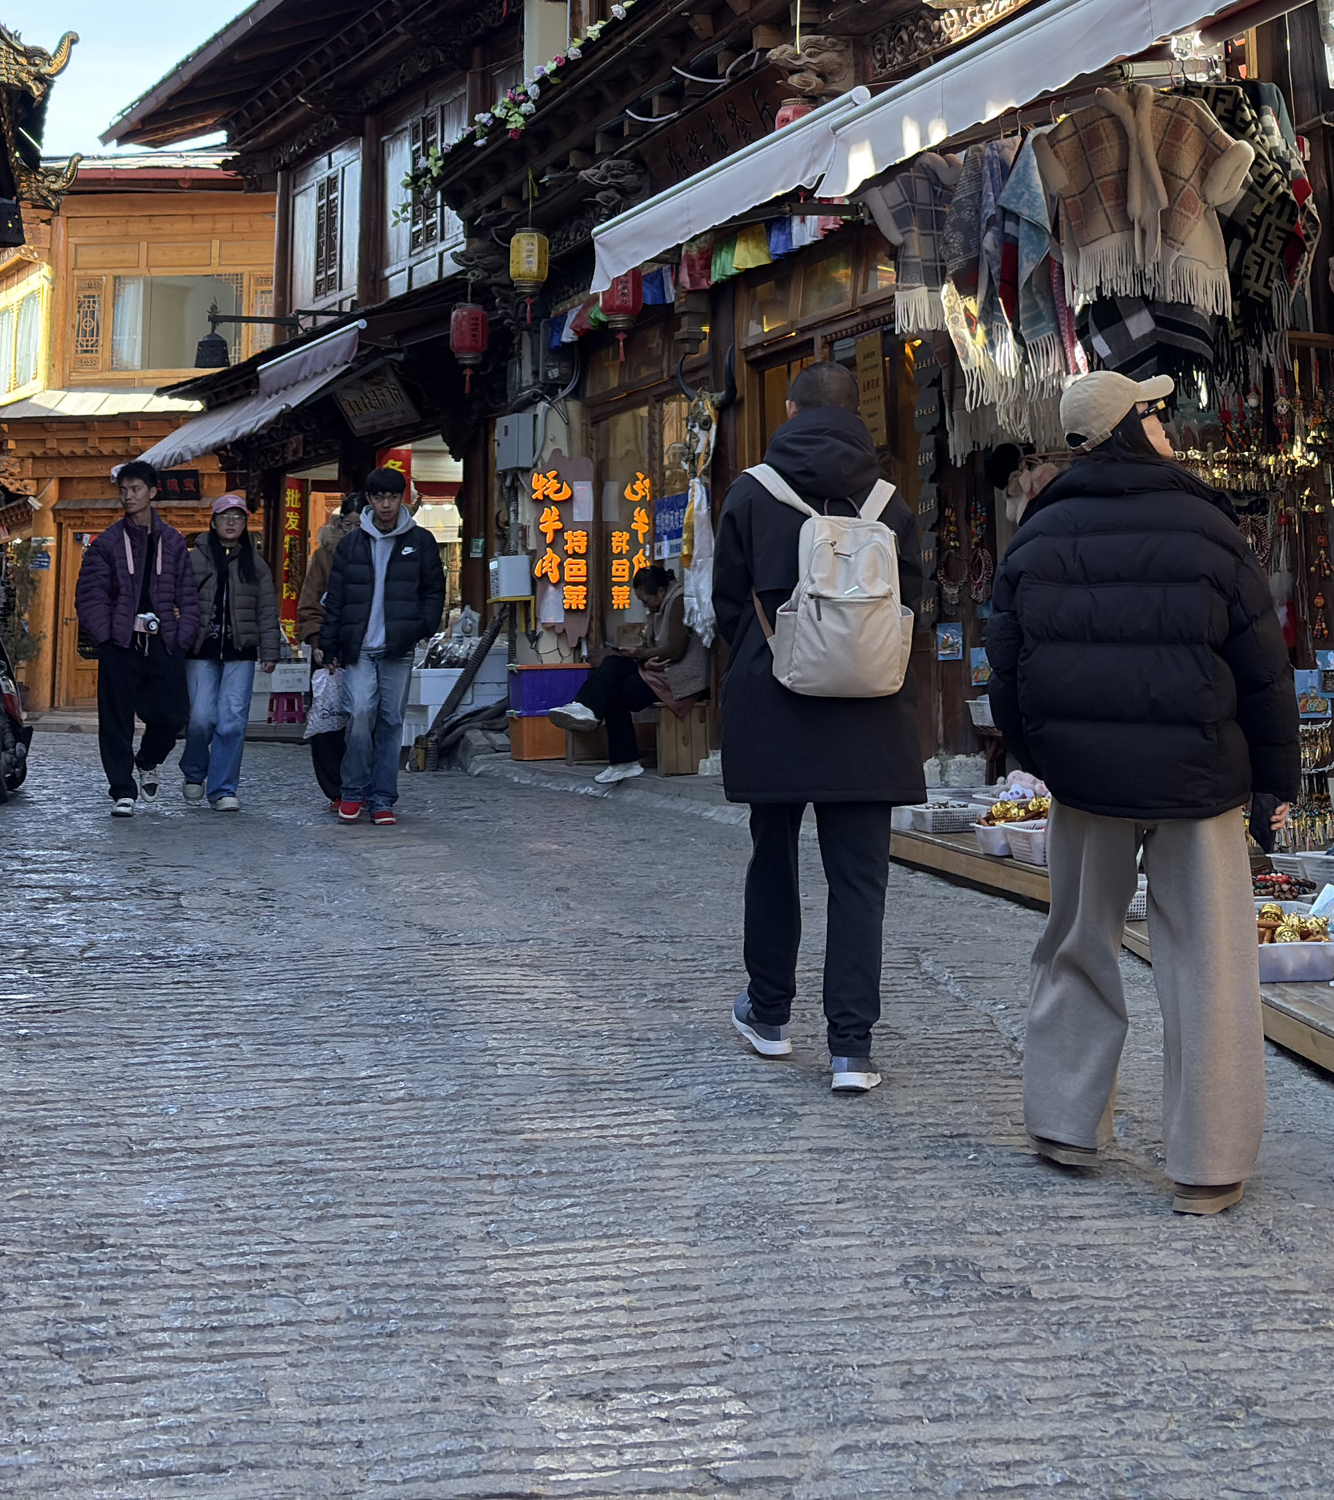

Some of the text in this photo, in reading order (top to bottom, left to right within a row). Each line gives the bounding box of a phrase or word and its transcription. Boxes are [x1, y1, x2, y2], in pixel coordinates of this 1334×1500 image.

[531, 470, 571, 584] 牦牛肉
[563, 530, 588, 610] 特色菜
